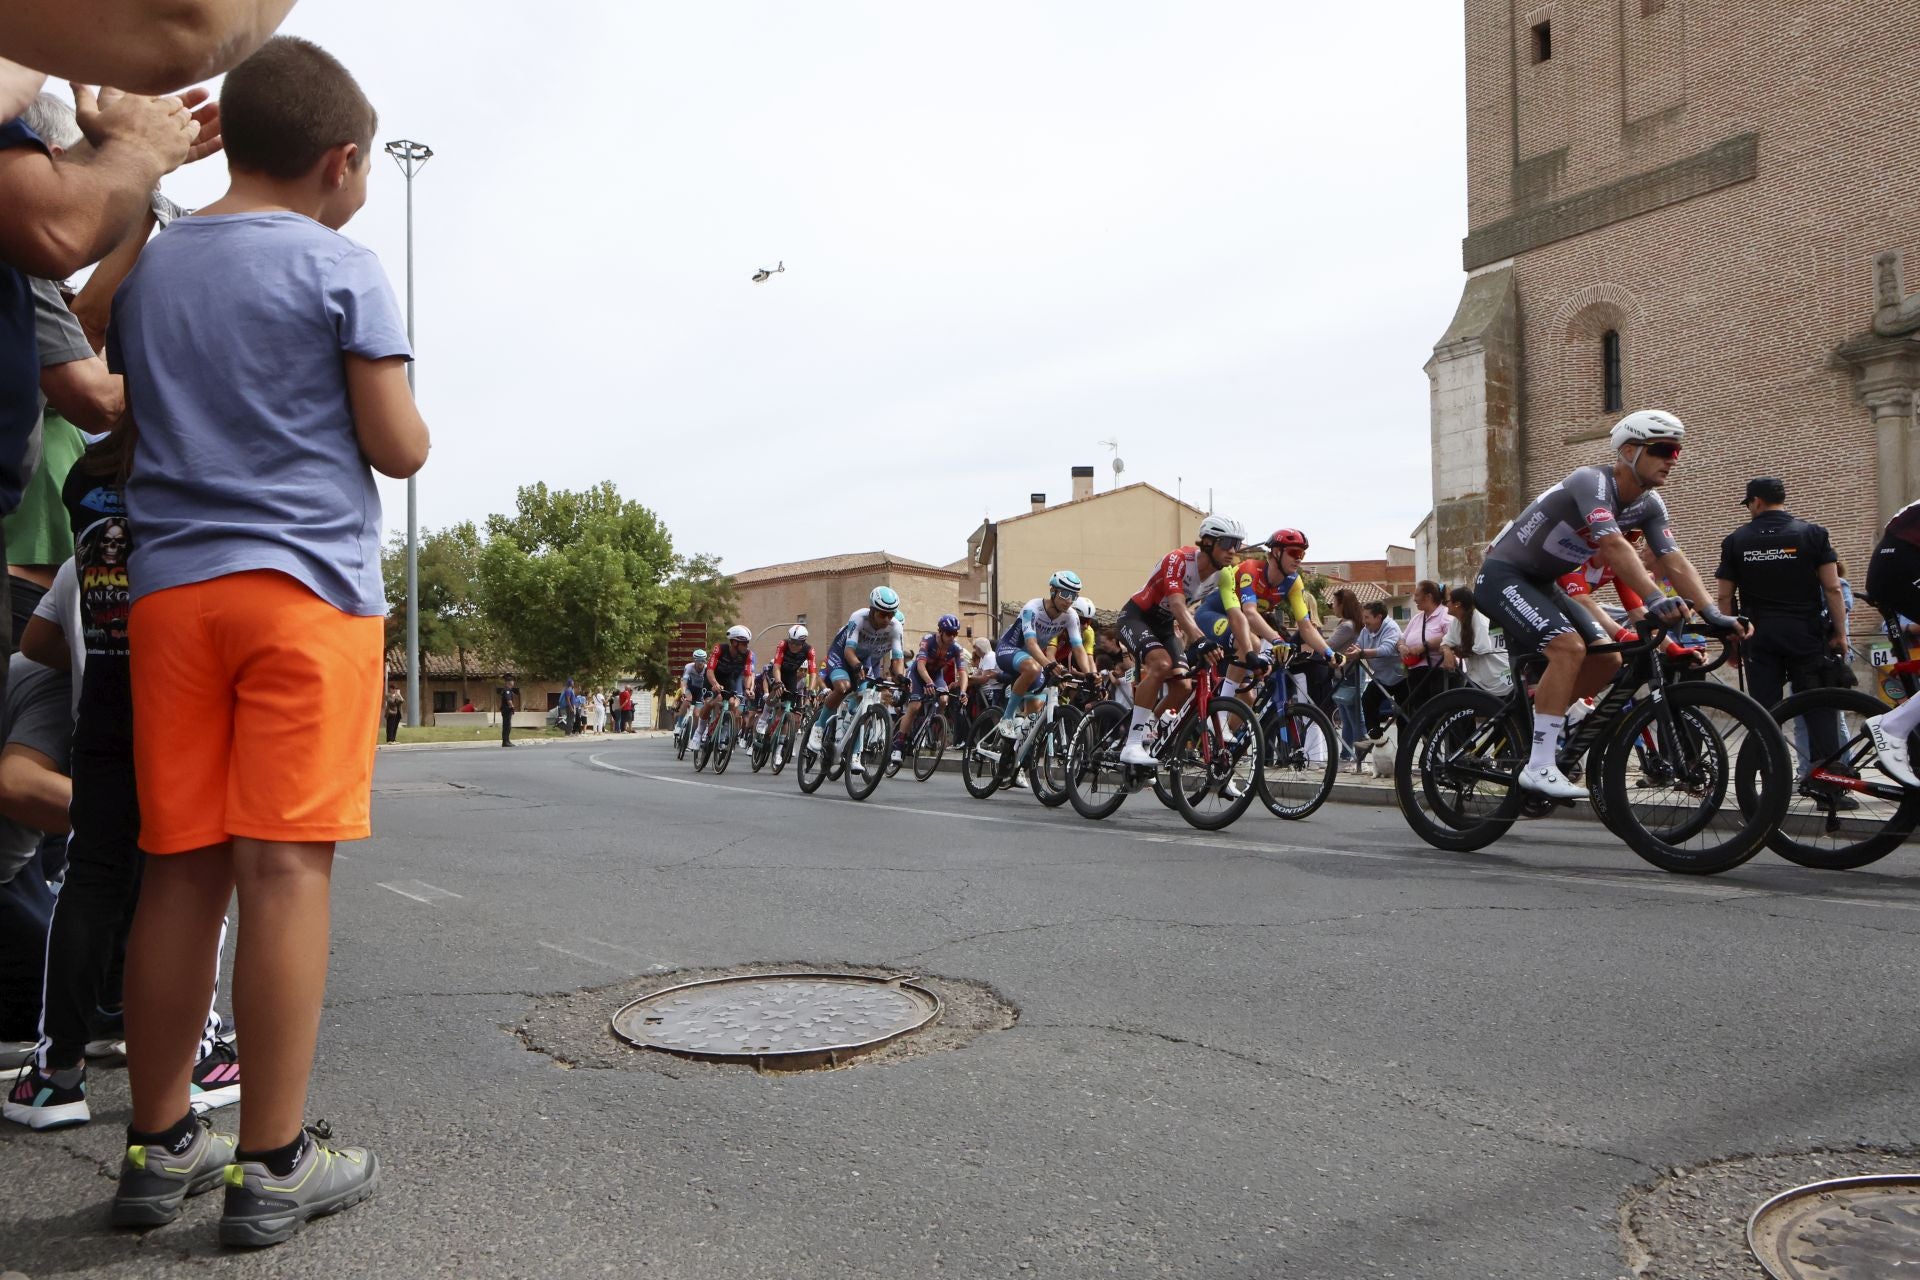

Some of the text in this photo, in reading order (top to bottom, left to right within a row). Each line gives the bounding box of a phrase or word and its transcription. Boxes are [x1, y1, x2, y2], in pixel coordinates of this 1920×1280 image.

[1516, 511, 1546, 544] Alpecin
[1744, 549, 1786, 557] POLICIA
[1744, 554, 1797, 562] NACIONAL
[84, 566, 129, 591] RAG
[1502, 584, 1550, 632] deceuninck
[1873, 651, 1888, 666] 64
[1871, 723, 1890, 753] nimbl
